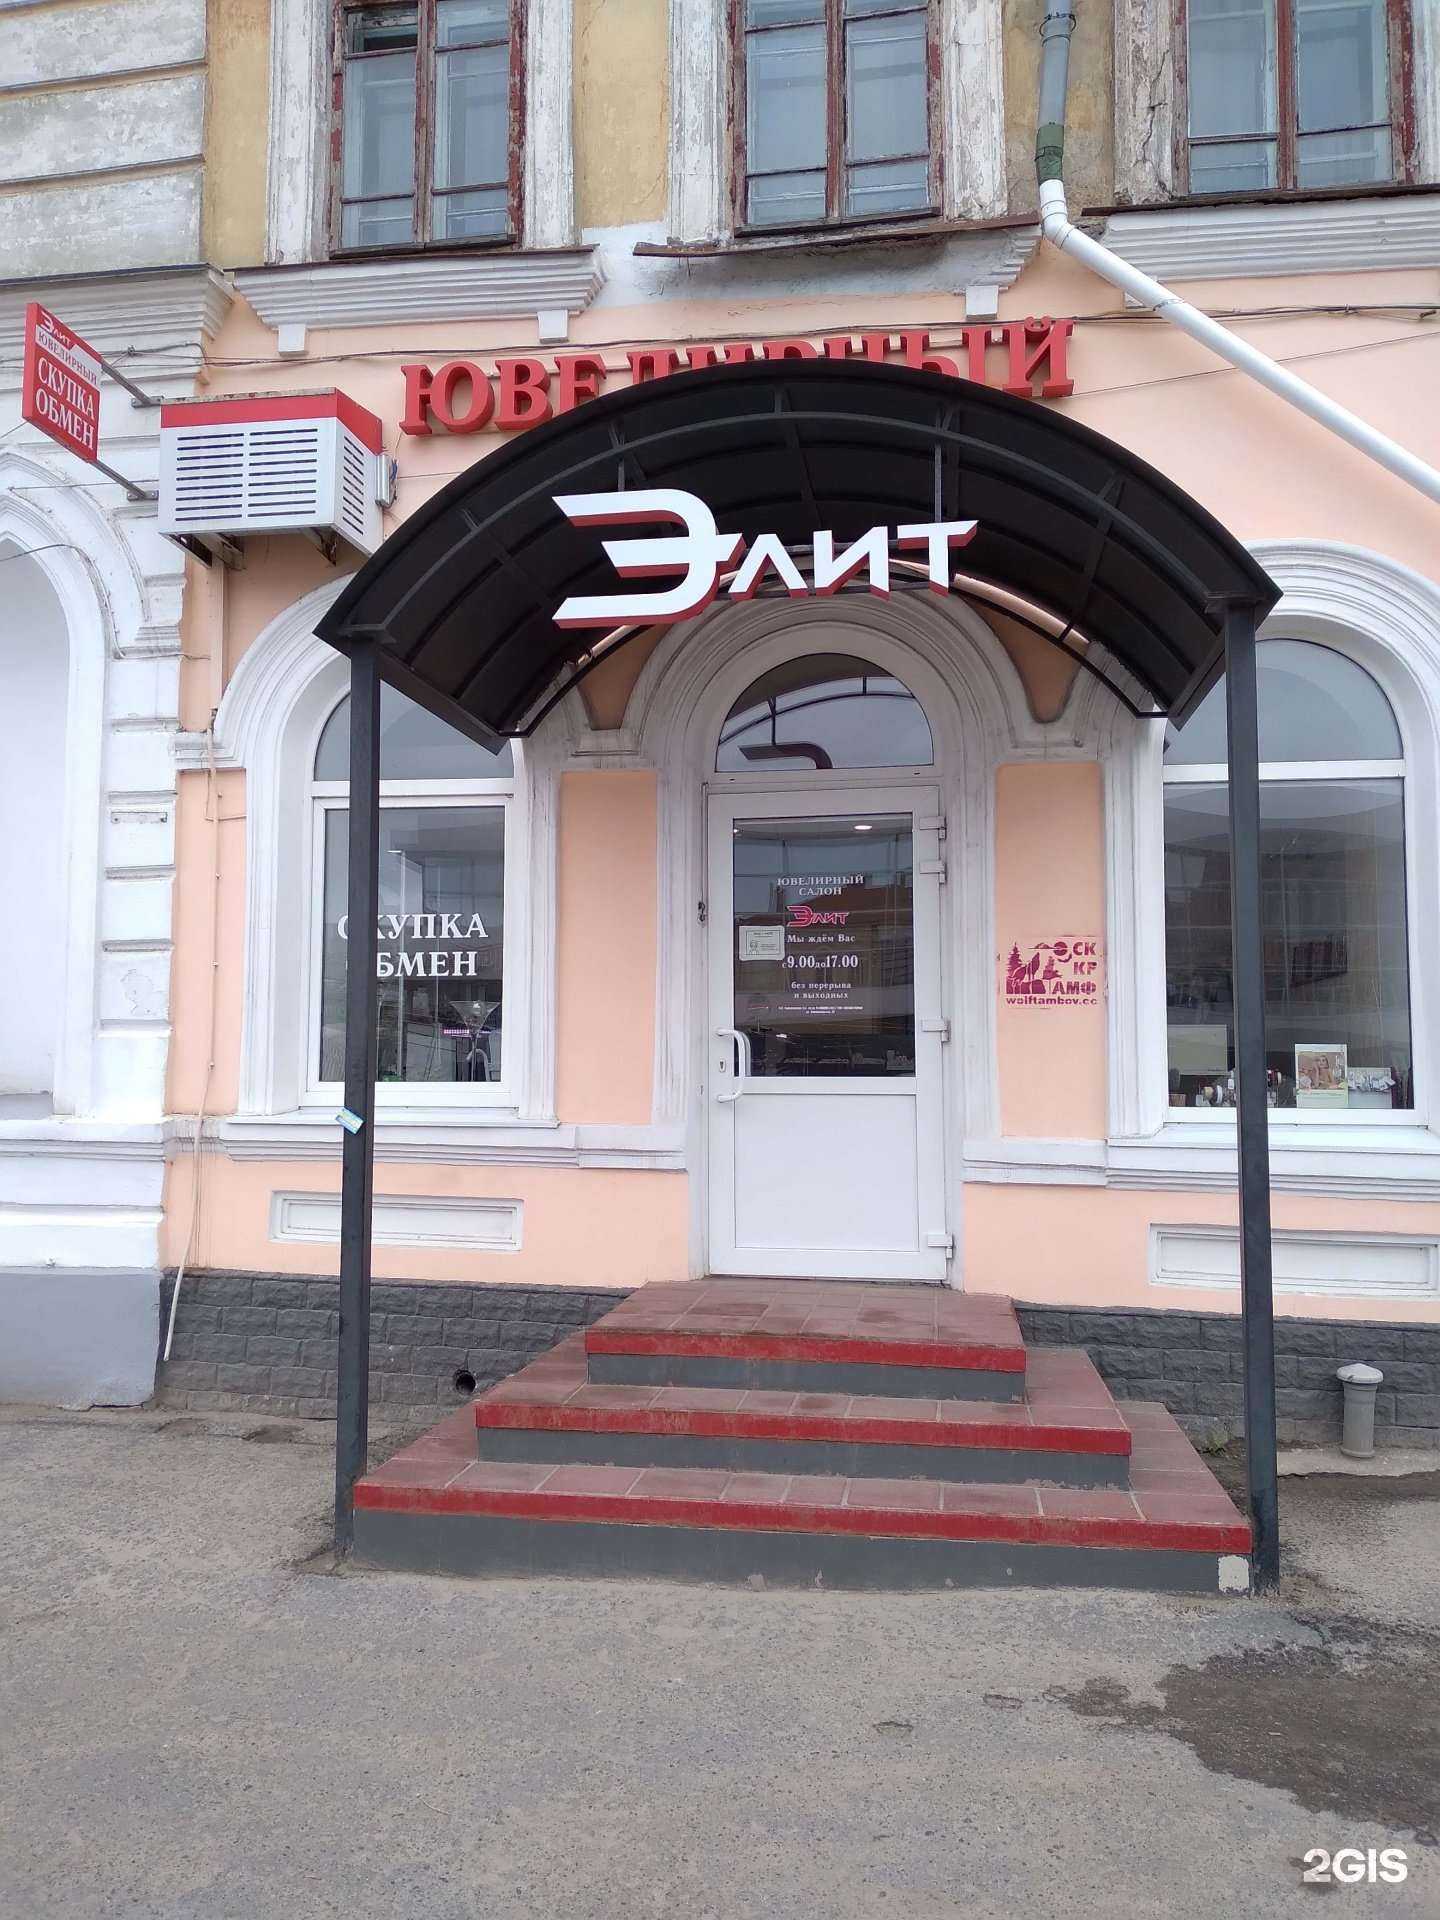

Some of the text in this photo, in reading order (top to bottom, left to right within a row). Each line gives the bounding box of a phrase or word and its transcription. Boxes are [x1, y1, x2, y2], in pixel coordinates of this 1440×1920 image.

[39, 331, 97, 385] ЮВЕЛИРНЫЙ
[38, 356, 95, 420] СКУПКА
[36, 388, 95, 450] ОБМЕН
[777, 873, 865, 886] ЮВЕЛИРНЫЙ
[798, 887, 842, 896] САЛОН
[787, 934, 856, 943] Мы ждём Вас
[345, 951, 478, 977] БМЕН
